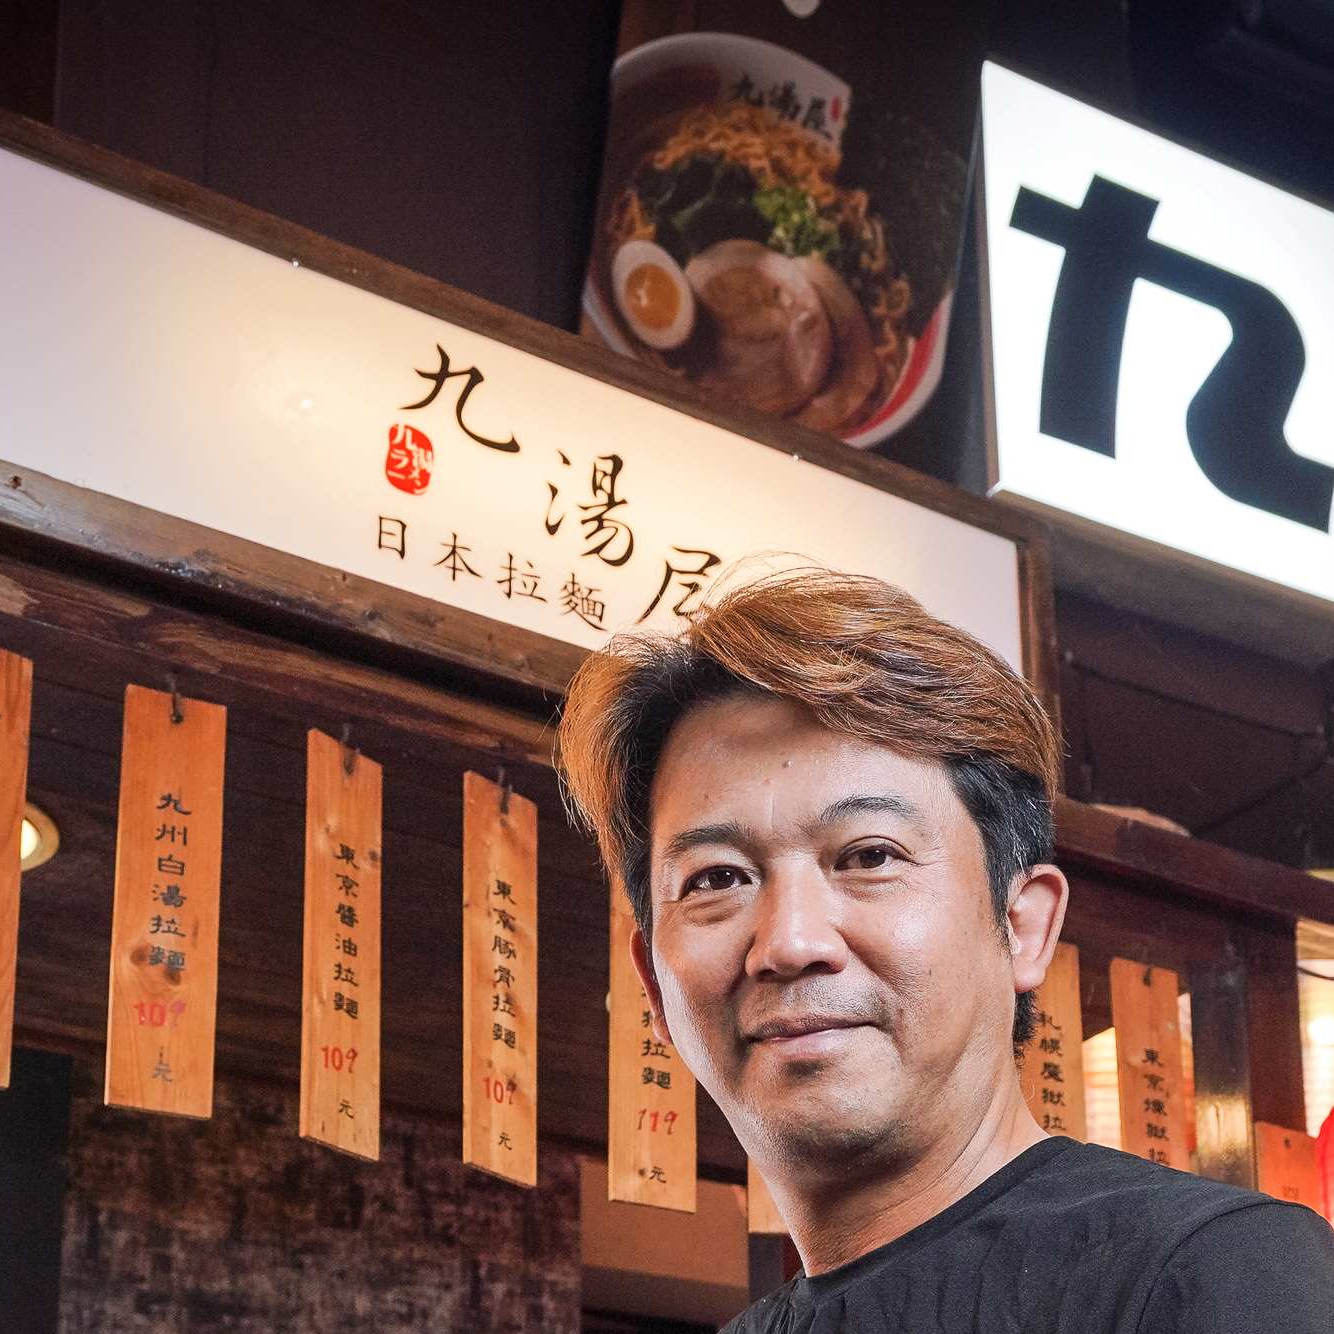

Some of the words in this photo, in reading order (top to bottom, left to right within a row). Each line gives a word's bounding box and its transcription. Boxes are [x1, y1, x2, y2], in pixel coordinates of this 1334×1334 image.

[377, 515, 610, 632] 日本拉麵
[320, 1045, 359, 1075] 109
[482, 1073, 519, 1106] 109
[337, 1099, 355, 1120] 元
[637, 1108, 678, 1135] 119
[498, 1131, 514, 1152] 元
[649, 1166, 667, 1184] 元
